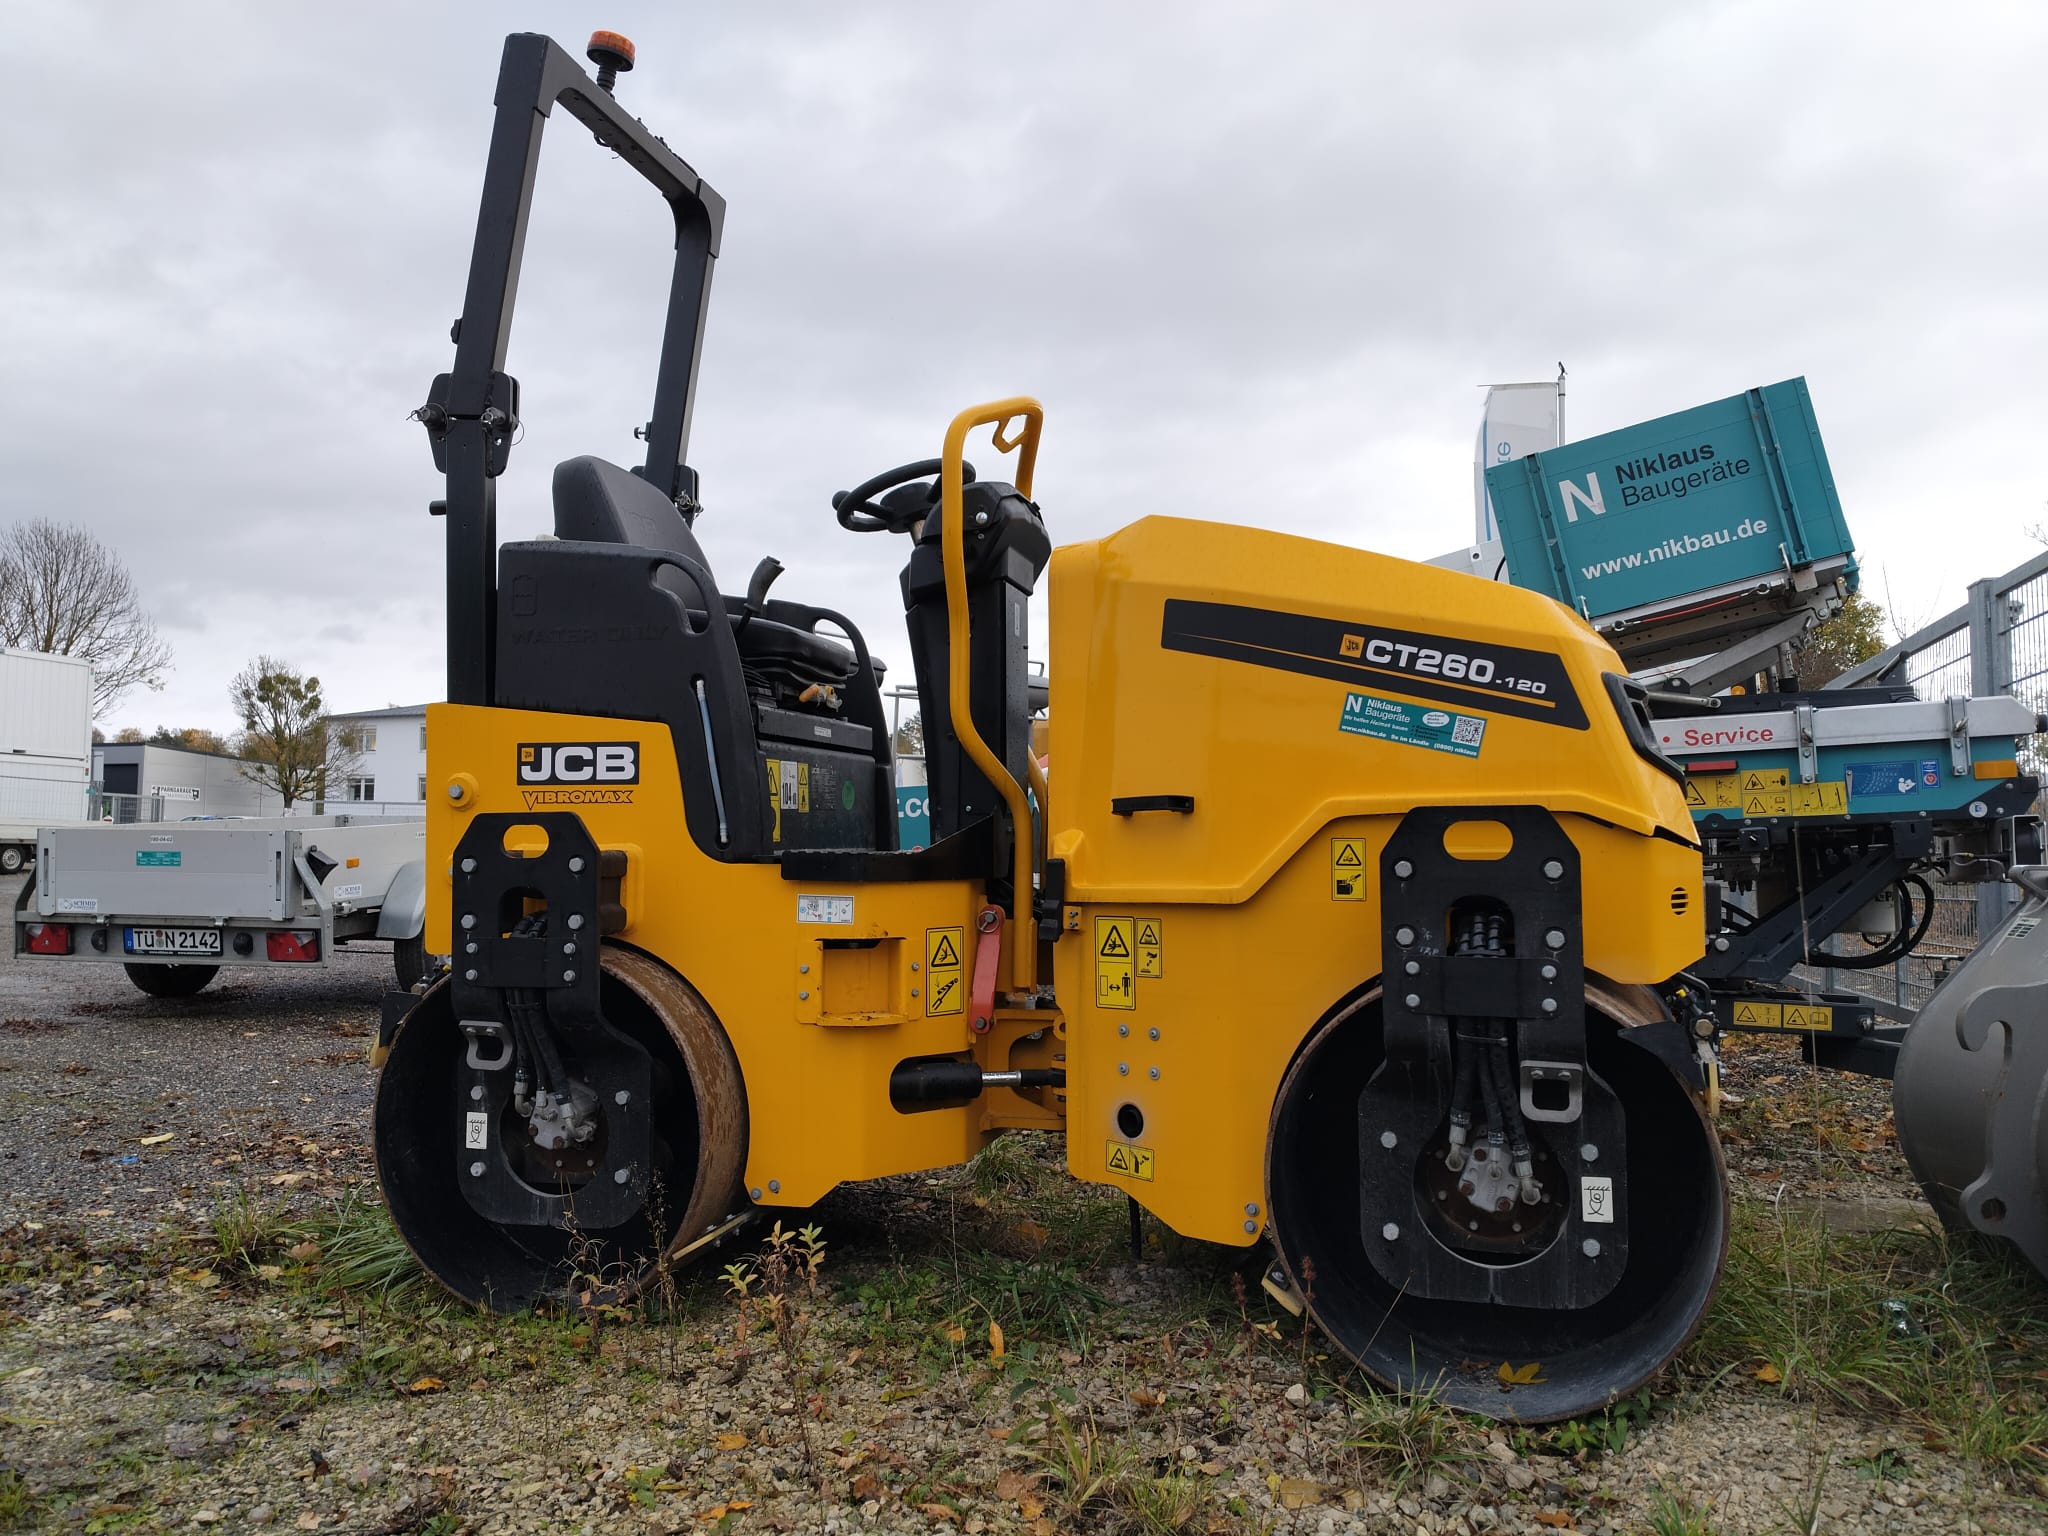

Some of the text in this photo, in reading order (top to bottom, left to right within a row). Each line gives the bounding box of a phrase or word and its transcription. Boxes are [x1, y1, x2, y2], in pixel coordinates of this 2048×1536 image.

[1615, 444, 1715, 485] Niklaus
[1621, 457, 1751, 507] Baugeräte
[1558, 472, 1606, 523] N
[1581, 518, 1768, 580] www.nikbau.de
[1345, 694, 1363, 713] N
[1364, 707, 1411, 724] Baugeräte
[1366, 698, 1403, 713] Niklaus
[1341, 725, 1388, 739] www.nikbau.de
[1454, 746, 1478, 757] niklaus
[1684, 726, 1774, 747] Service
[521, 746, 635, 781] JCB
[521, 790, 634, 811] VIBROMAX
[134, 930, 155, 948] TÜ
[164, 930, 176, 948] N
[179, 931, 219, 949] 2142
